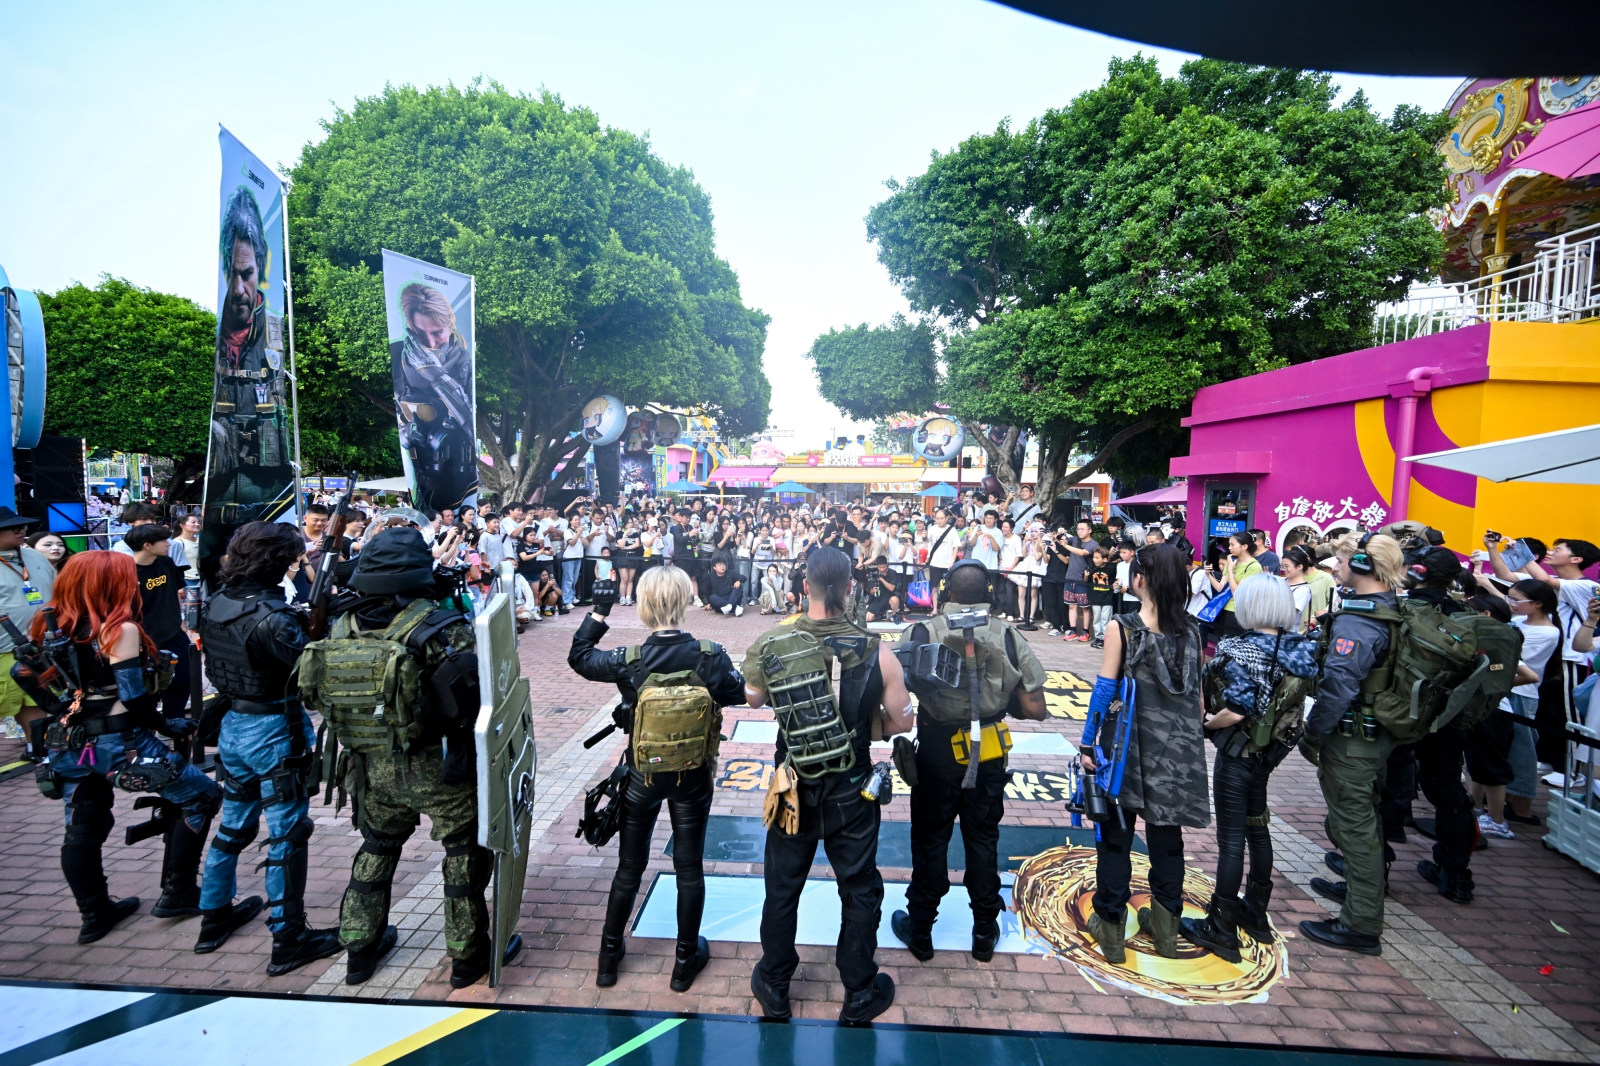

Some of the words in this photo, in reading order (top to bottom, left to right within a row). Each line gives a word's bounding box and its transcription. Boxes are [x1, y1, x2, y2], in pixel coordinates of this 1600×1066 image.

[1274, 495, 1387, 527] 自信放大器
[146, 575, 166, 590] drew
